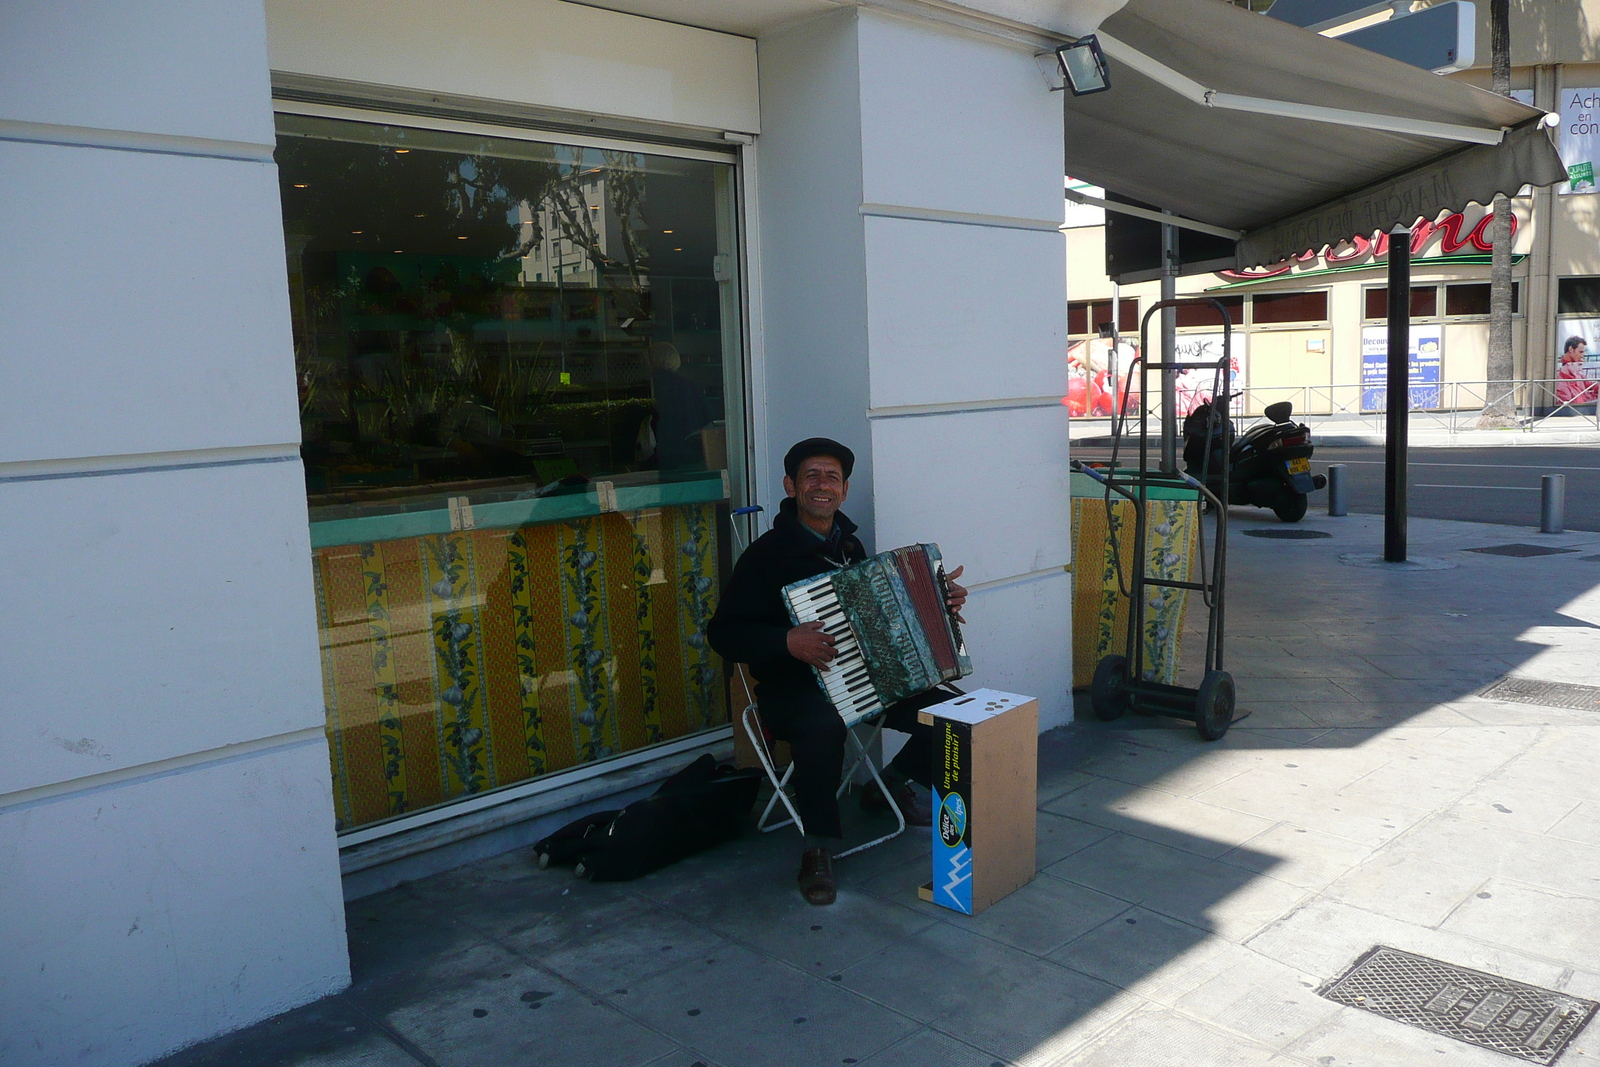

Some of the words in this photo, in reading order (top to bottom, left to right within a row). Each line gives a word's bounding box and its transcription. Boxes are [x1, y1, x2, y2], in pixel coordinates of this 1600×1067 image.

[1578, 113, 1591, 122] en
[1570, 123, 1600, 135] con
[944, 722, 953, 770] montagne
[943, 771, 951, 790] Une
[952, 769, 959, 782] de
[942, 813, 950, 840] Délice
